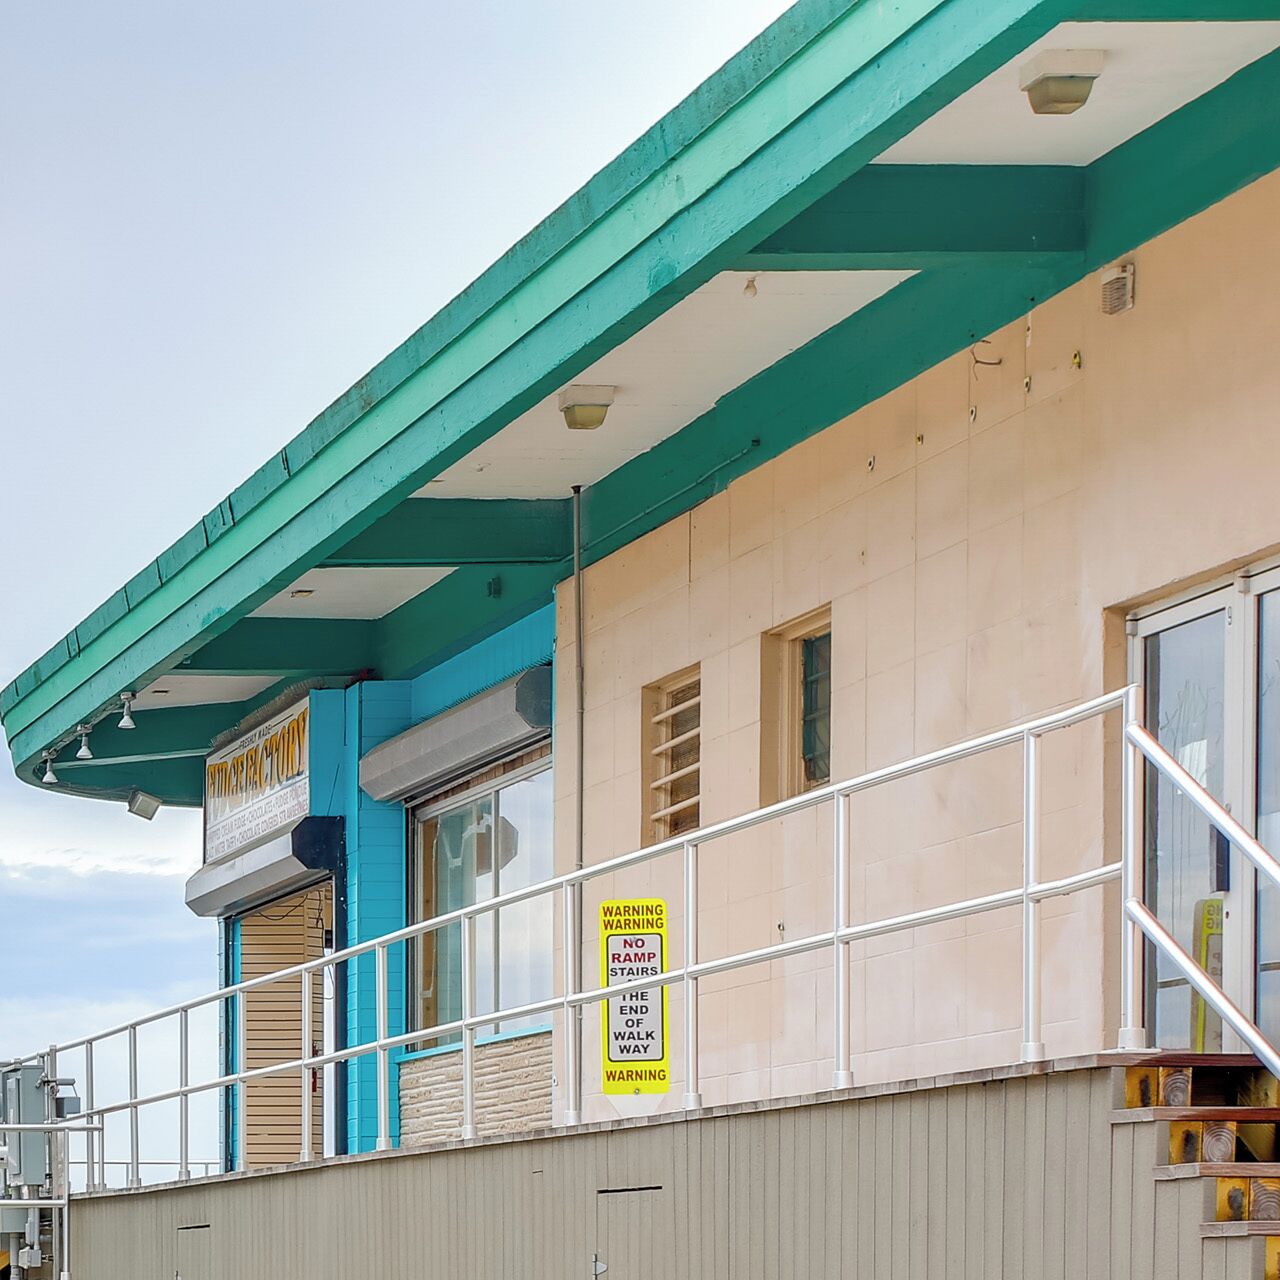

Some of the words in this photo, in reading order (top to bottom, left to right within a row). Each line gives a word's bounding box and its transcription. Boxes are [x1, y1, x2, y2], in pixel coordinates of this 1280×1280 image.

[258, 724, 271, 740] MADE
[207, 755, 246, 816] FUDGE
[246, 707, 308, 792] FACTORY
[603, 904, 663, 918] WARNING
[603, 917, 664, 930] WARNING
[623, 938, 645, 949] NO
[611, 952, 657, 963] RAMP
[610, 966, 658, 976] STAIRS
[619, 1005, 649, 1015] END
[625, 1018, 644, 1028] OF
[613, 1031, 656, 1041] WALK
[618, 1044, 650, 1054] WAY
[605, 1069, 667, 1082] WARNING
